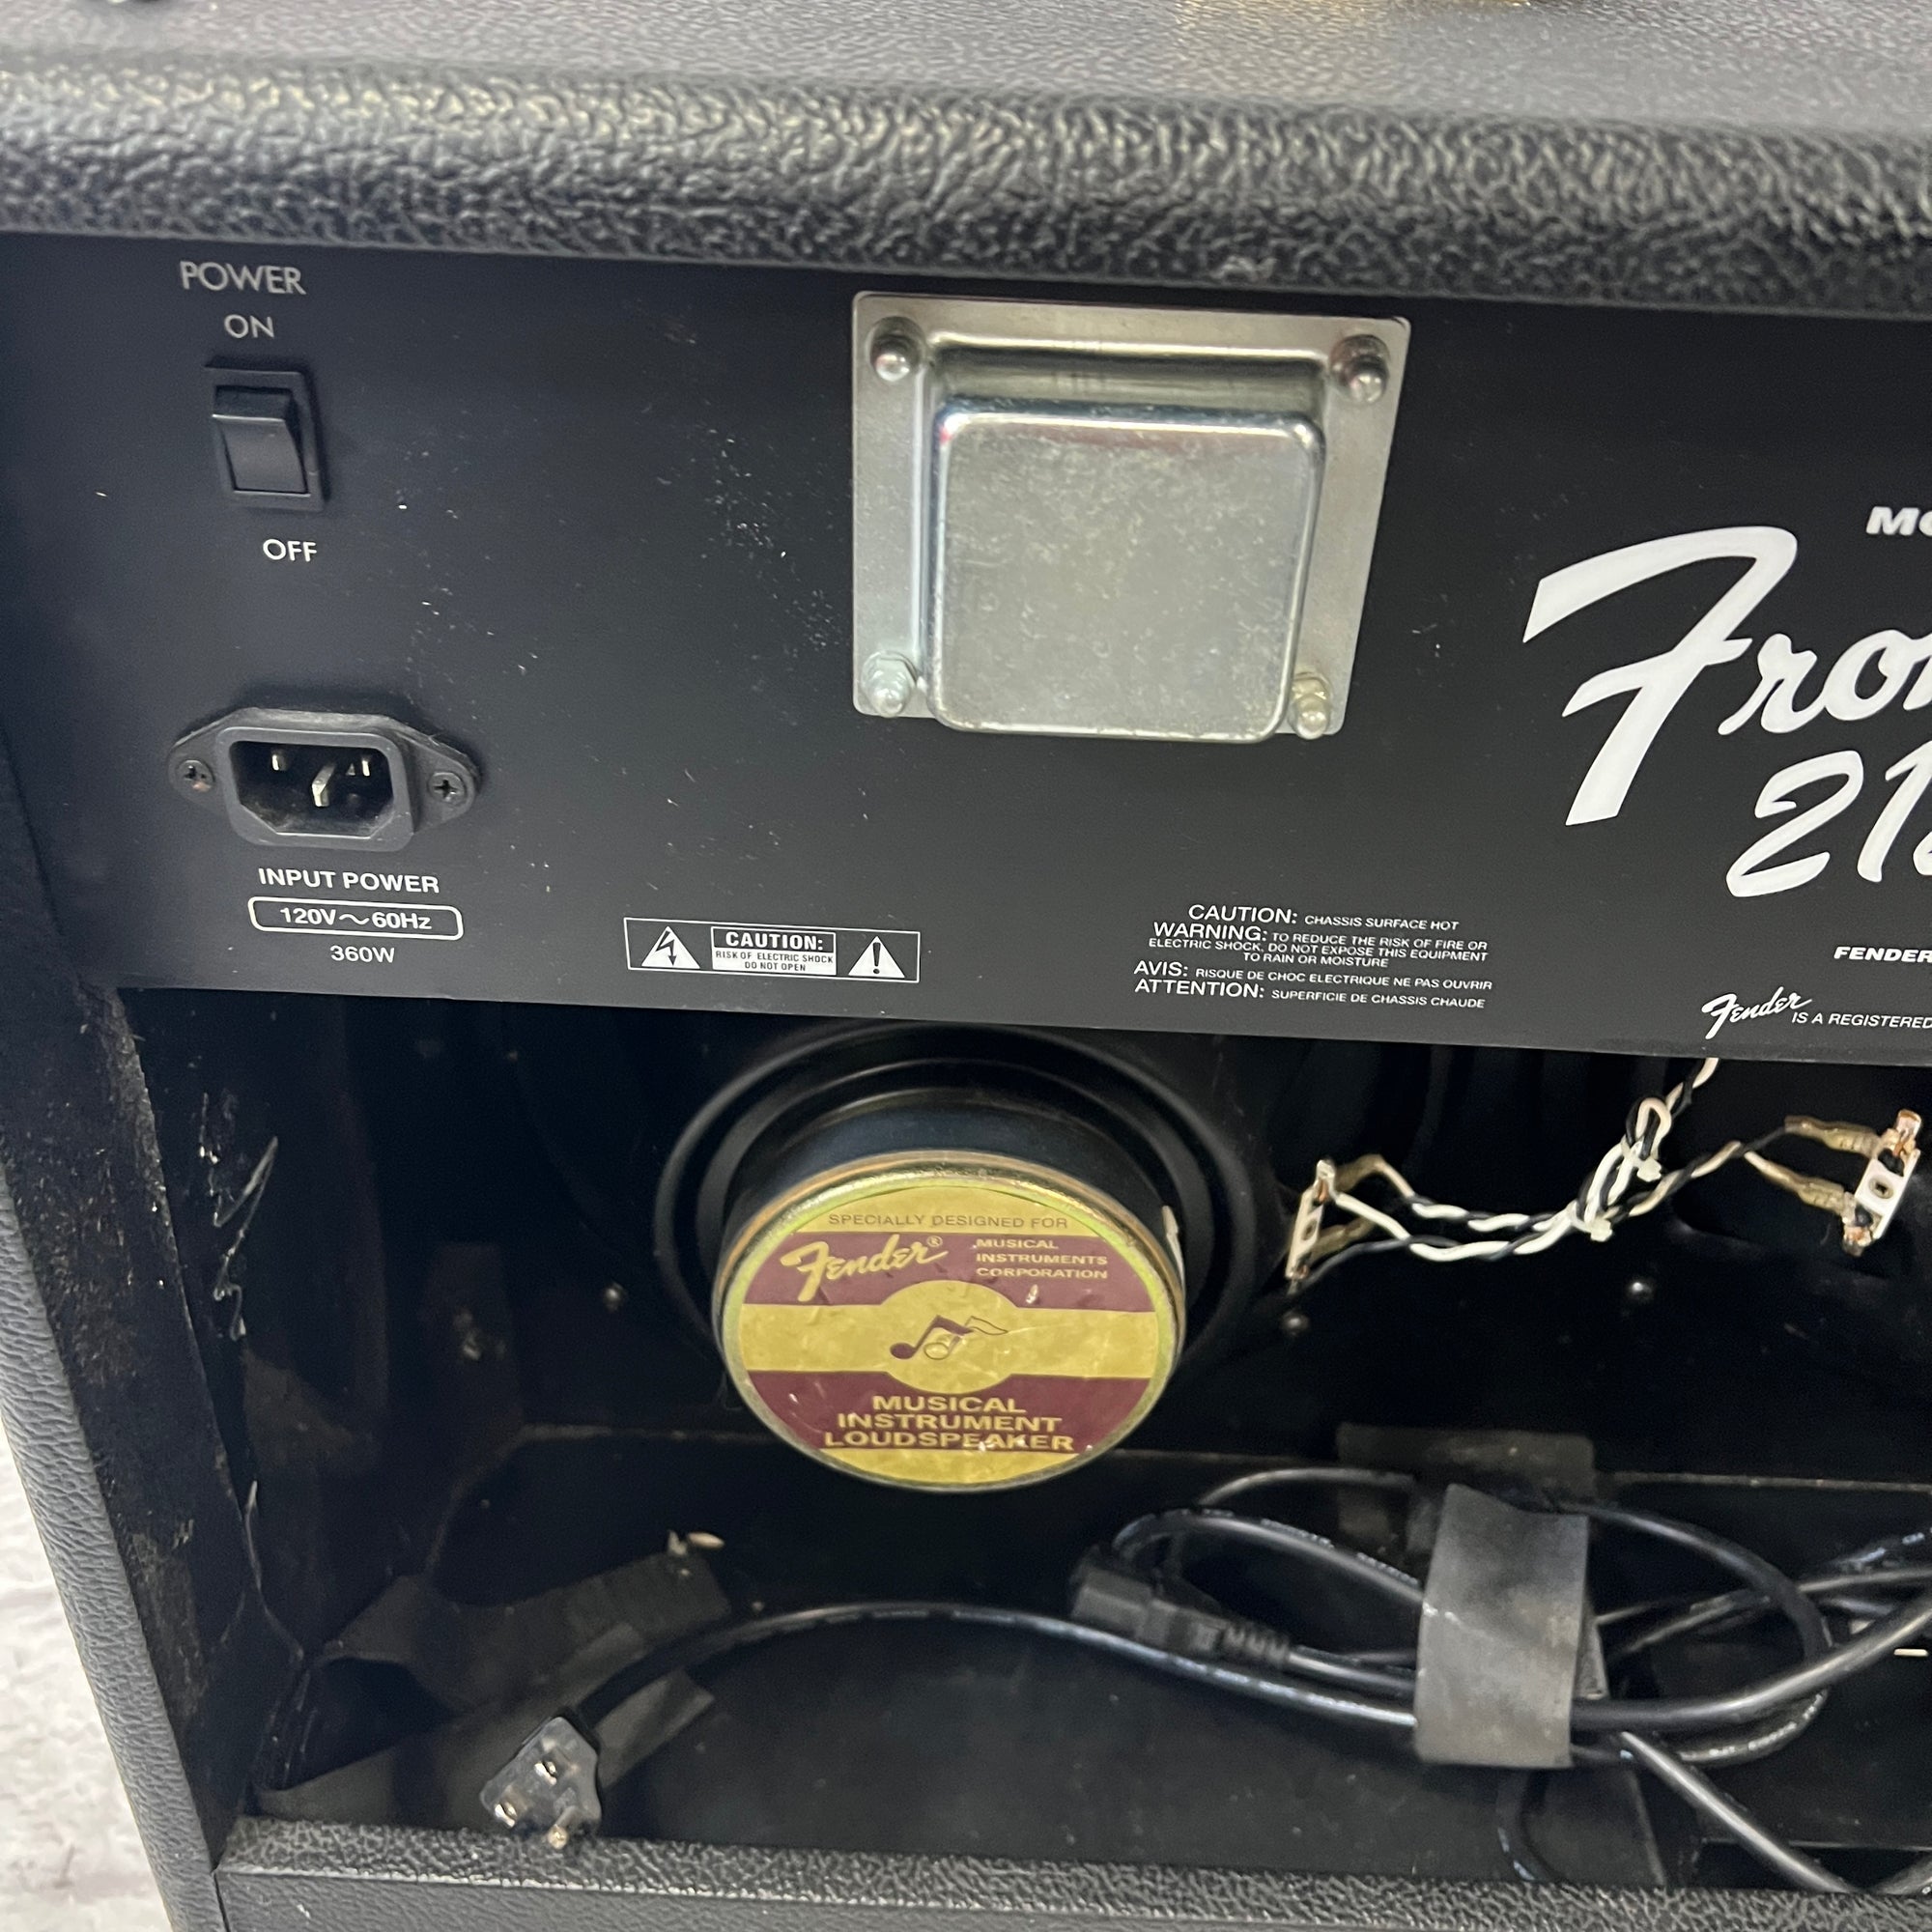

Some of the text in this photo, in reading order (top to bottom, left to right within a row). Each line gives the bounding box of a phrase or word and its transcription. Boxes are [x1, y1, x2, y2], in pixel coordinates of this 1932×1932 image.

[180, 260, 306, 295] POWER
[224, 314, 275, 338] ON
[263, 538, 318, 562] OFF
[1726, 740, 1932, 897] 21
[258, 867, 440, 894] INPUT POWER
[1188, 904, 1459, 930] CAUTION: CHASSIS SURFACE HOT
[725, 931, 823, 951] CAUTION:
[1153, 922, 1488, 951] WARNING: TO REDUCE THE RISK OF FIRE OR
[329, 945, 395, 963] 360W
[715, 951, 738, 959] RISK
[757, 952, 799, 962] ELECTRIC
[803, 954, 834, 963] SHOCK
[1149, 937, 1211, 950] ELECTRIC
[1267, 943, 1288, 952] DO
[1291, 944, 1318, 954] NOT
[1321, 945, 1374, 956] EXPOSE
[1378, 947, 1406, 958] THIS
[1409, 949, 1489, 962] EQUIPMENT
[1833, 946, 1932, 963] FENDER
[781, 963, 806, 972] OPEN
[1243, 952, 1389, 968] TO RAIN OR MOISTURE
[1133, 959, 1492, 990] AVIS: RISQUE DE CHOC ELECTRIQUE NE PAS OUVRIR
[1134, 978, 1486, 1009] ATTENTION: SUPERFICIE DE CHASSIS CHAUDE
[1701, 986, 1932, 1040] Fender IS A REGISTERED
[828, 1213, 1068, 1229] SPECIALLY DESIGNED FOR
[977, 1238, 1059, 1250] MUSICAL
[977, 1253, 1108, 1265] INSTRUMENTS
[977, 1267, 1108, 1279] CORPORATION
[872, 1395, 1027, 1414] MUSICAL
[838, 1413, 1063, 1433] INSTRUMENT
[825, 1431, 1075, 1452] LOUDSPEAKER
